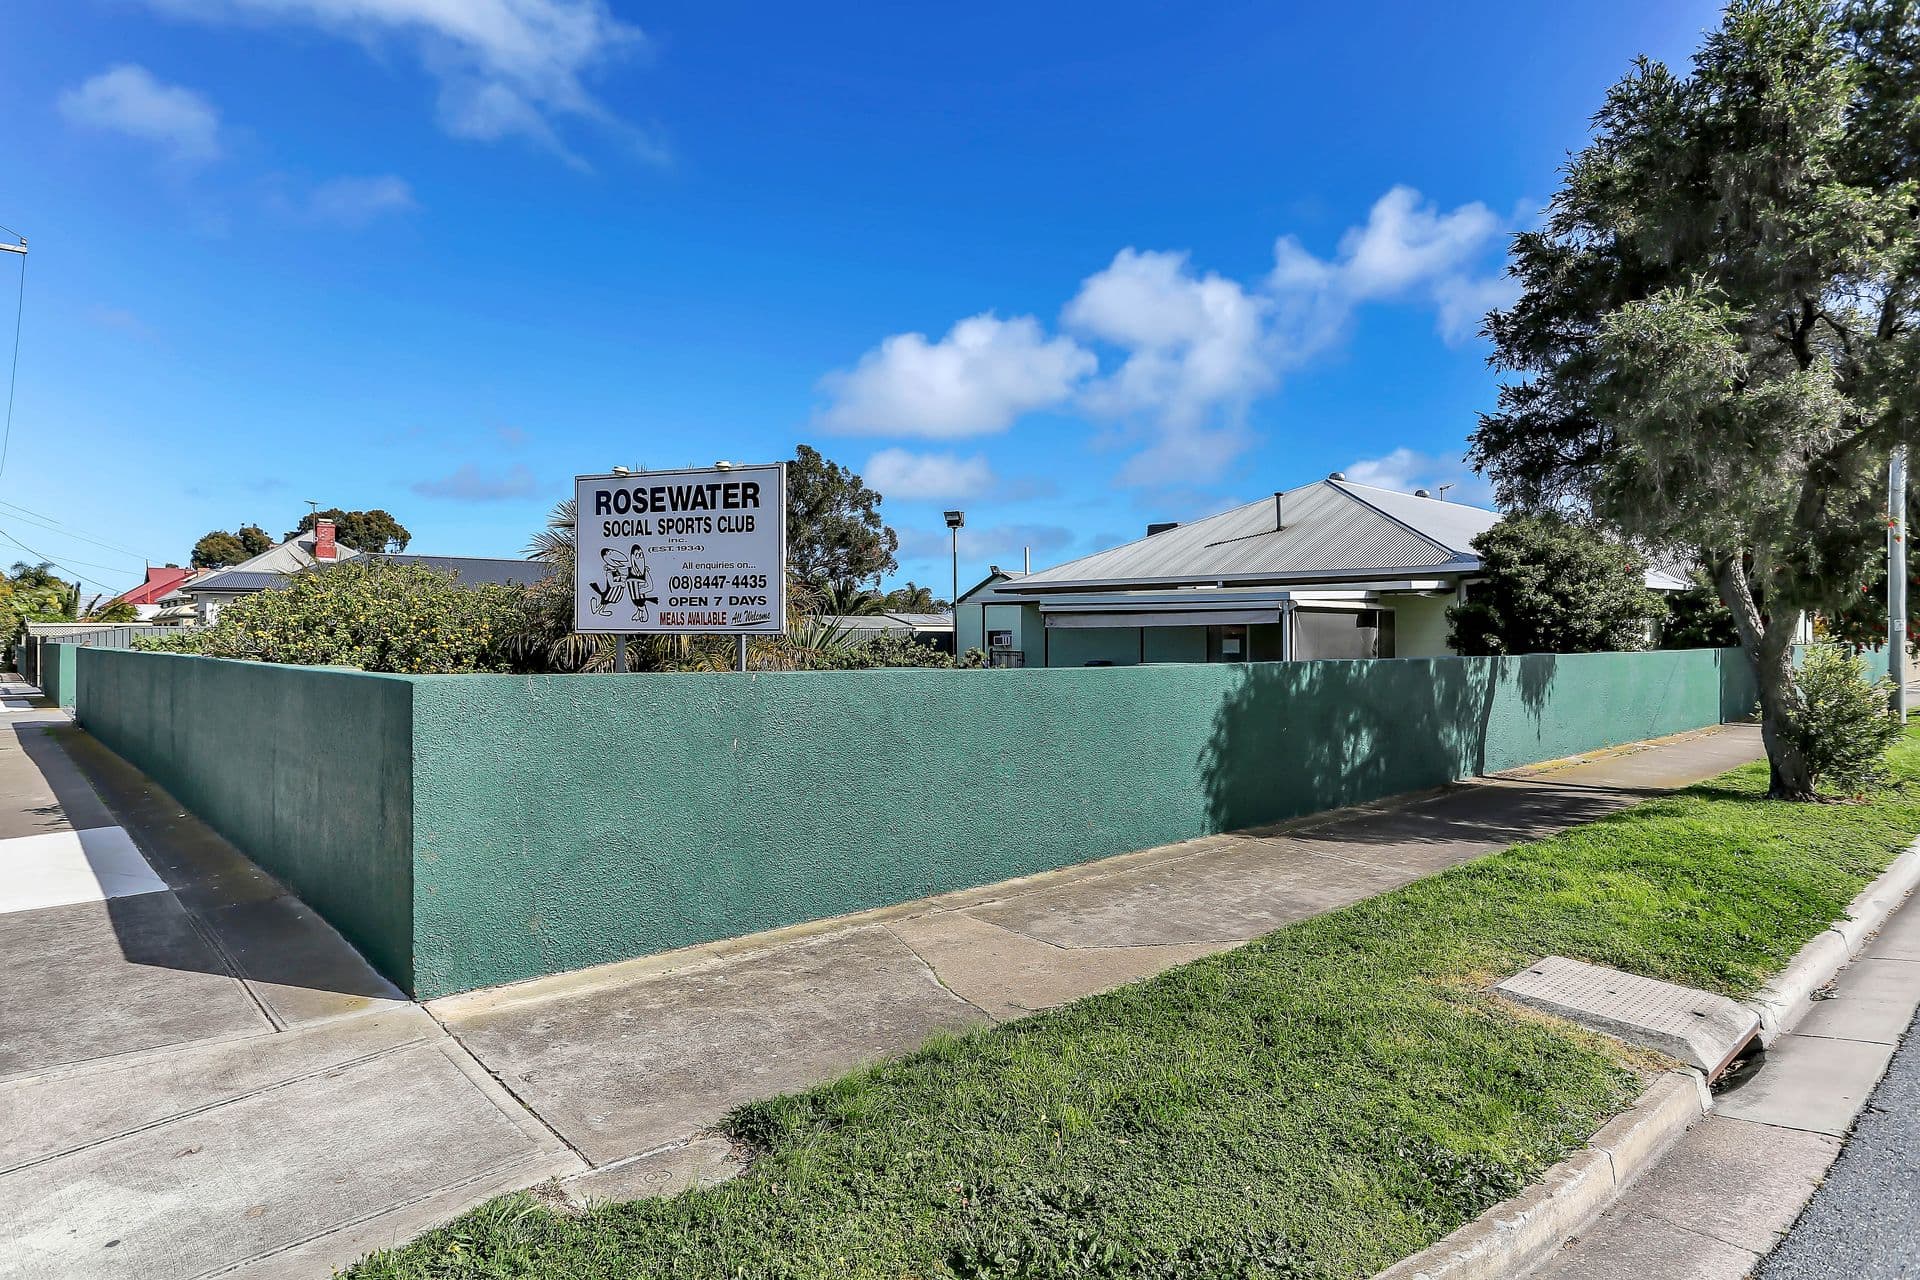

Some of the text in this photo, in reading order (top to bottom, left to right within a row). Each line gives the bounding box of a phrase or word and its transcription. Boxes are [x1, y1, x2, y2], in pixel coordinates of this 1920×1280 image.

[595, 482, 760, 515] ROSEWATER
[603, 515, 755, 537] SOCIAL SPORTS CLUB
[682, 562, 693, 570] All
[695, 562, 734, 570] enquiries
[669, 574, 767, 593] (08)8447-4435
[669, 596, 767, 606] OPEN 7 DAYS
[660, 612, 726, 626] MEALS AVAILABLE
[731, 610, 770, 624] All Welcome
